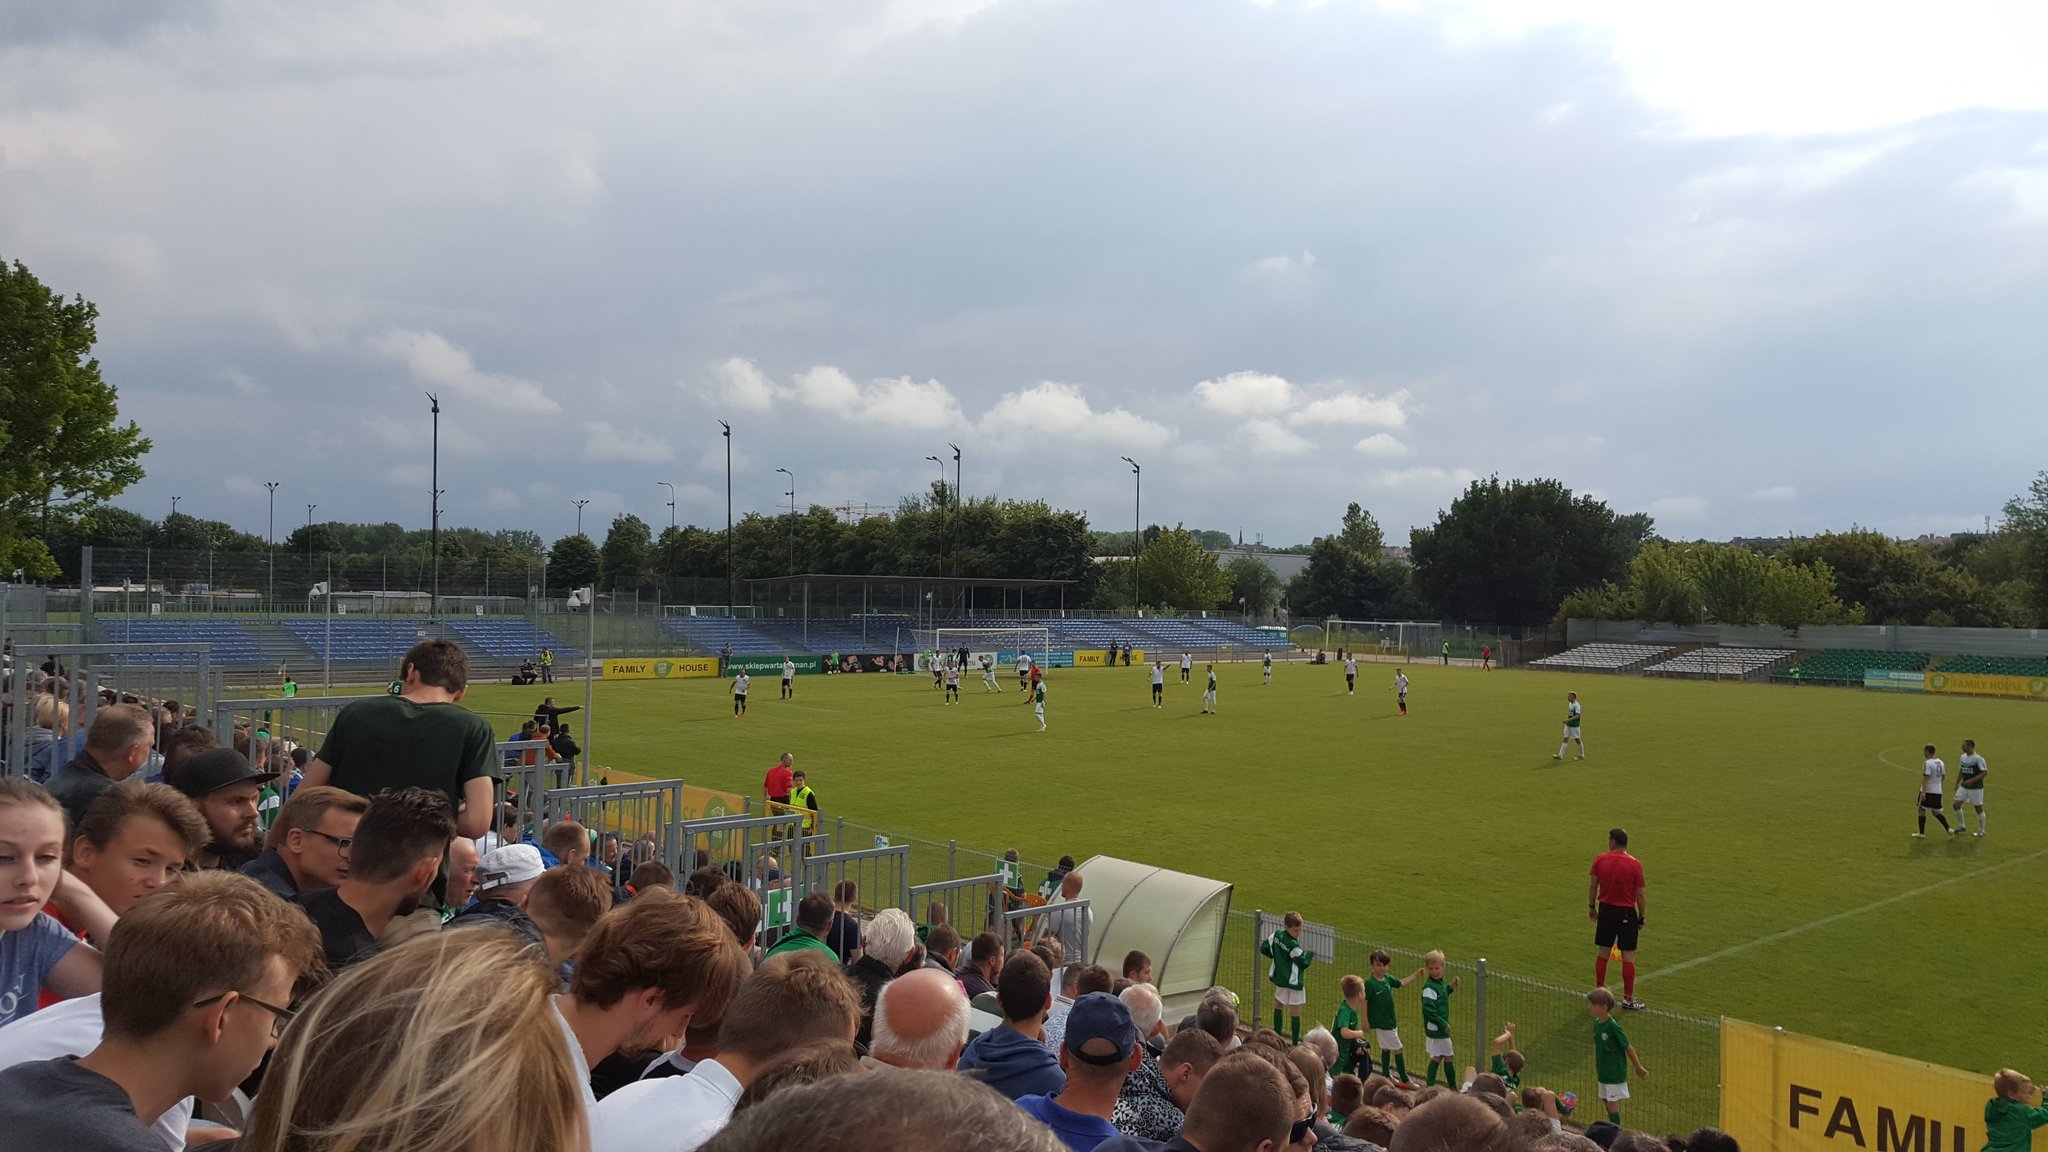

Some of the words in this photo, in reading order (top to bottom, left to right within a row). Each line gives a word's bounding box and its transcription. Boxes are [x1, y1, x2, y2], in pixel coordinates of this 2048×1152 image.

[613, 665, 646, 674] FAMILY
[679, 664, 709, 672] HOUSE
[394, 685, 400, 693] 6
[1953, 680, 1986, 689] FAMILY
[1990, 681, 2023, 691] HOUSE
